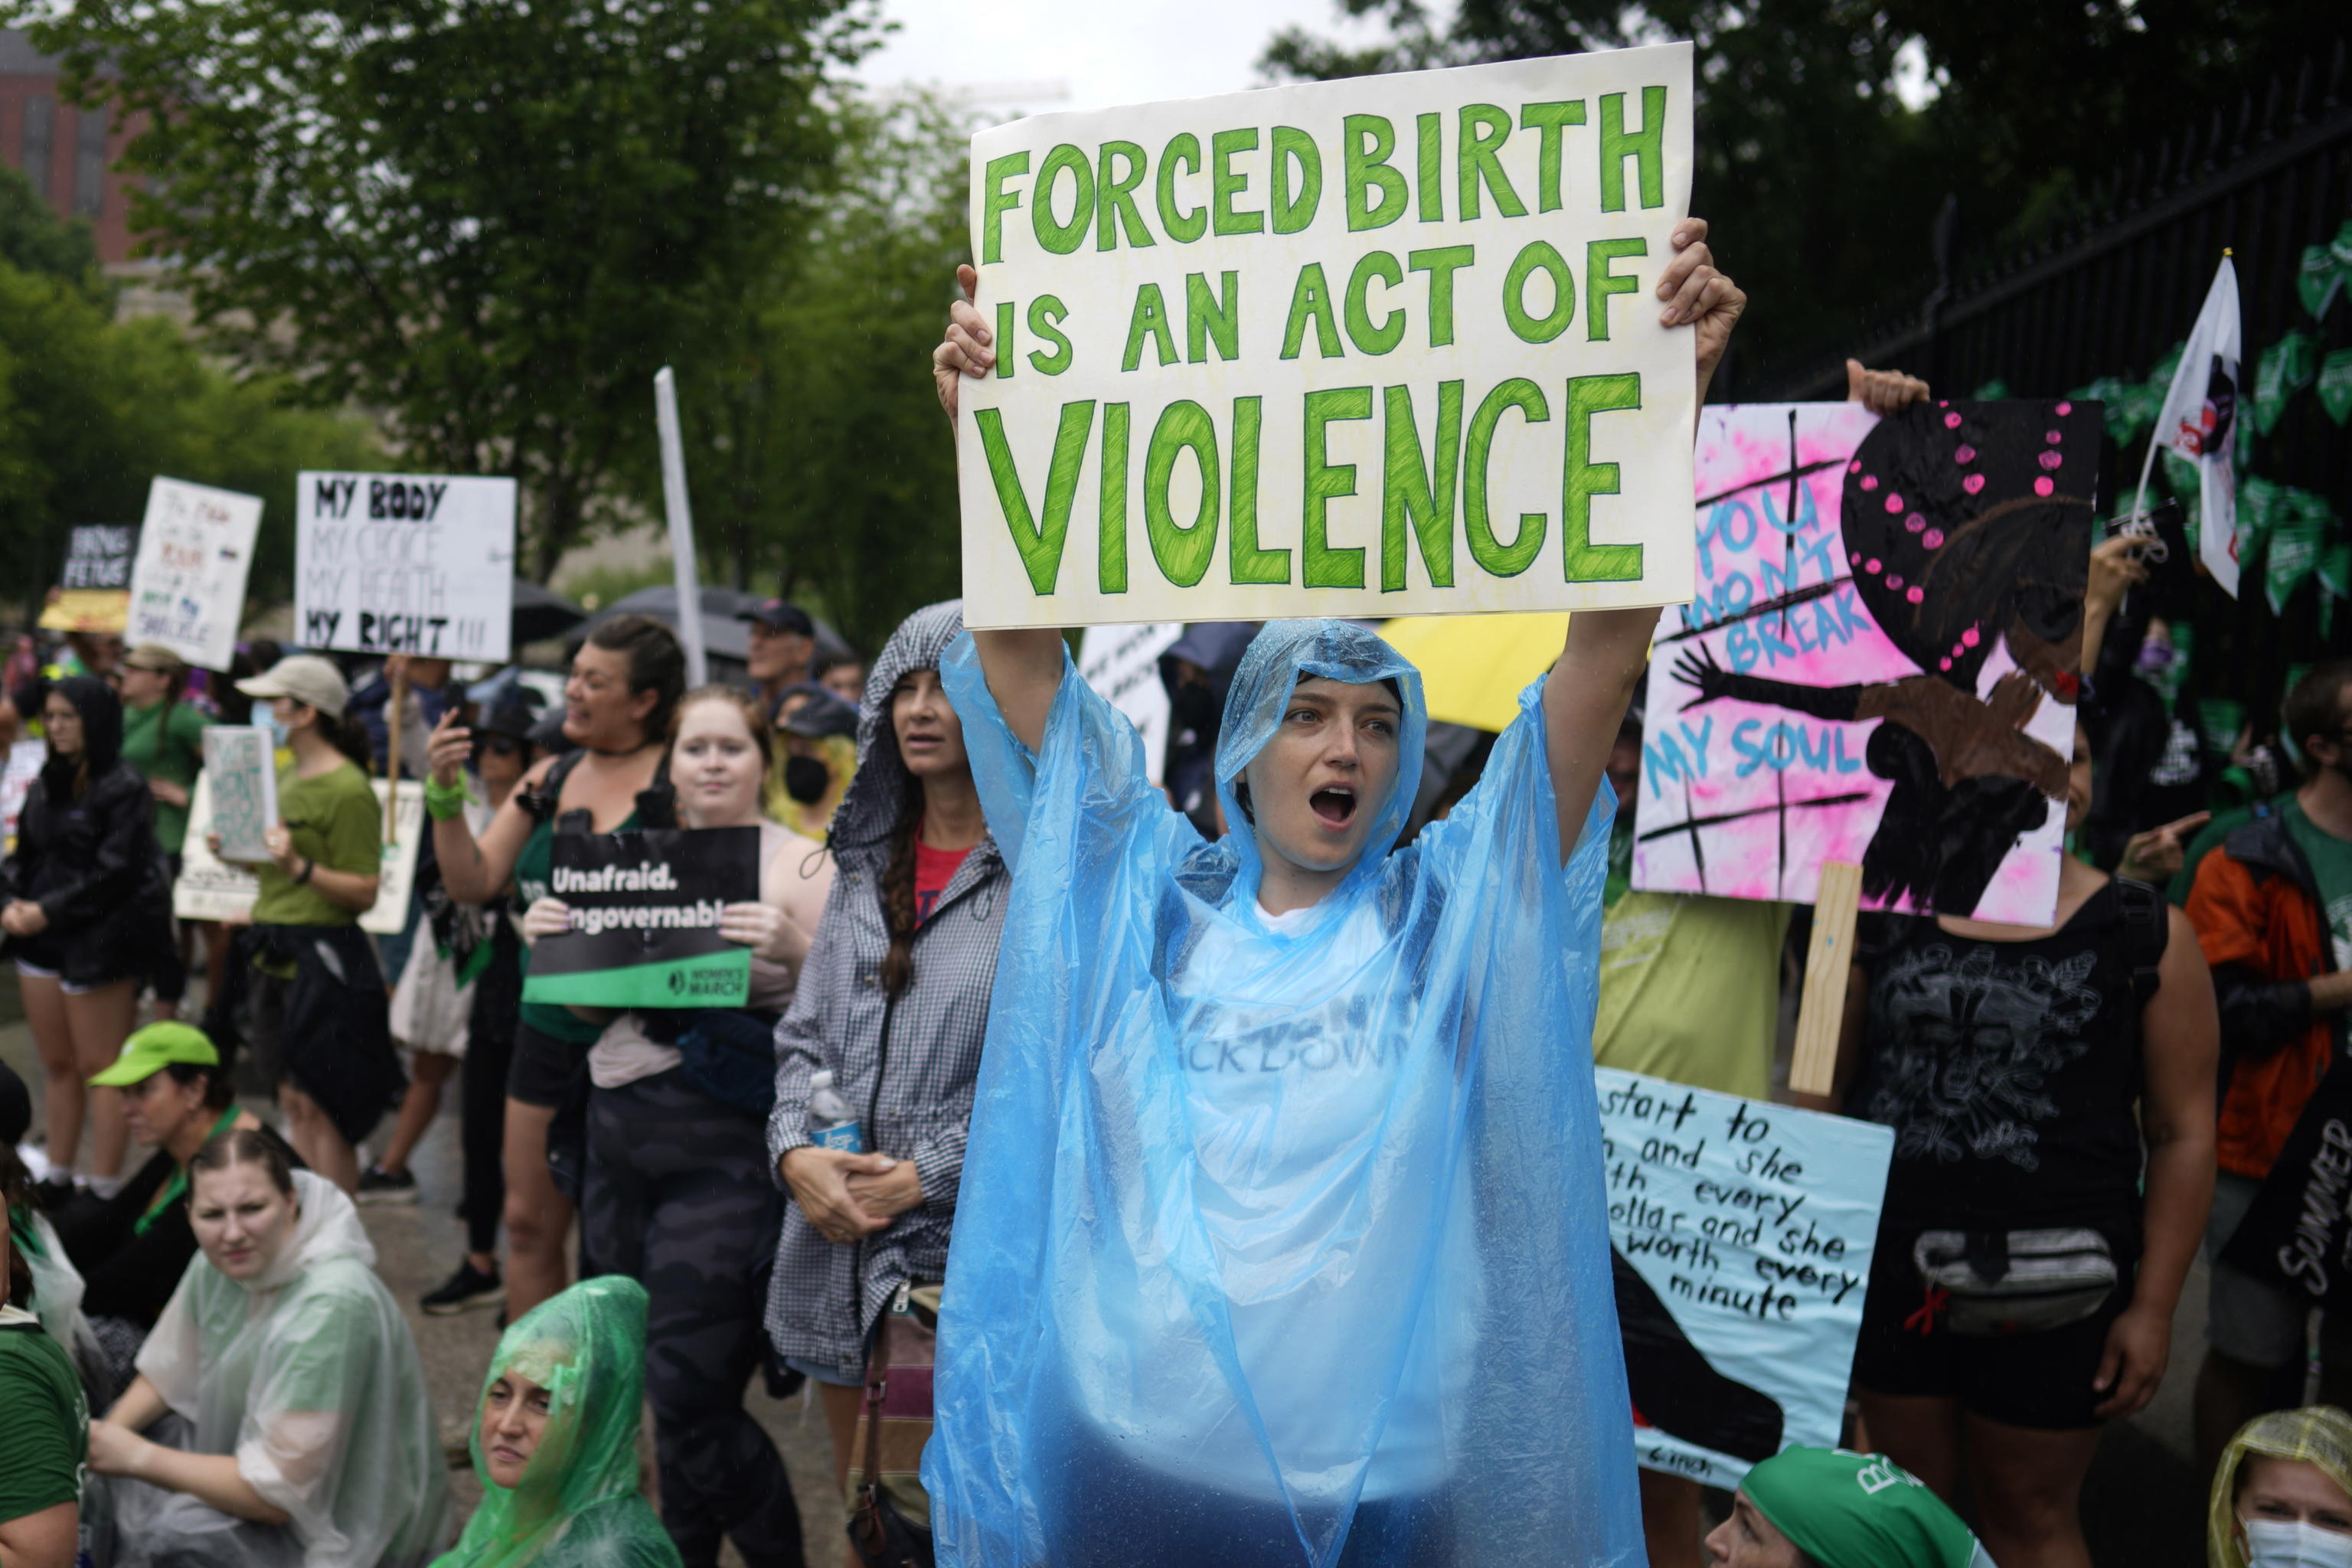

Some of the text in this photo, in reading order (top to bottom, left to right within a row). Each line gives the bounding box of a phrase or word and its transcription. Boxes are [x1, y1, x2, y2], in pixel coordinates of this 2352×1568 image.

[981, 86, 1668, 264] FORCED BIRTH
[995, 237, 1648, 379] IS AN ACT OF
[315, 479, 448, 521] MY BODY
[973, 372, 1644, 596] VIOLENCE
[311, 524, 443, 567] MY CHOICE
[1695, 477, 1821, 580] YOU
[306, 566, 446, 612] MY HEALTH
[306, 608, 341, 649] MY
[1726, 585, 1872, 676] BREAK
[1642, 714, 1861, 799] MY SOUL
[552, 861, 678, 893] Unafraid.
[567, 899, 724, 935] ngovernabl
[1599, 1080, 1770, 1144] start to
[1640, 1136, 1706, 1169] and
[1736, 1145, 1803, 1184] she
[1609, 1195, 1846, 1262] ollar and she
[1694, 1180, 1806, 1227] every
[2277, 1119, 2352, 1295] SUMMER
[1627, 1232, 1860, 1306] worth every
[1670, 1274, 1798, 1321] minute
